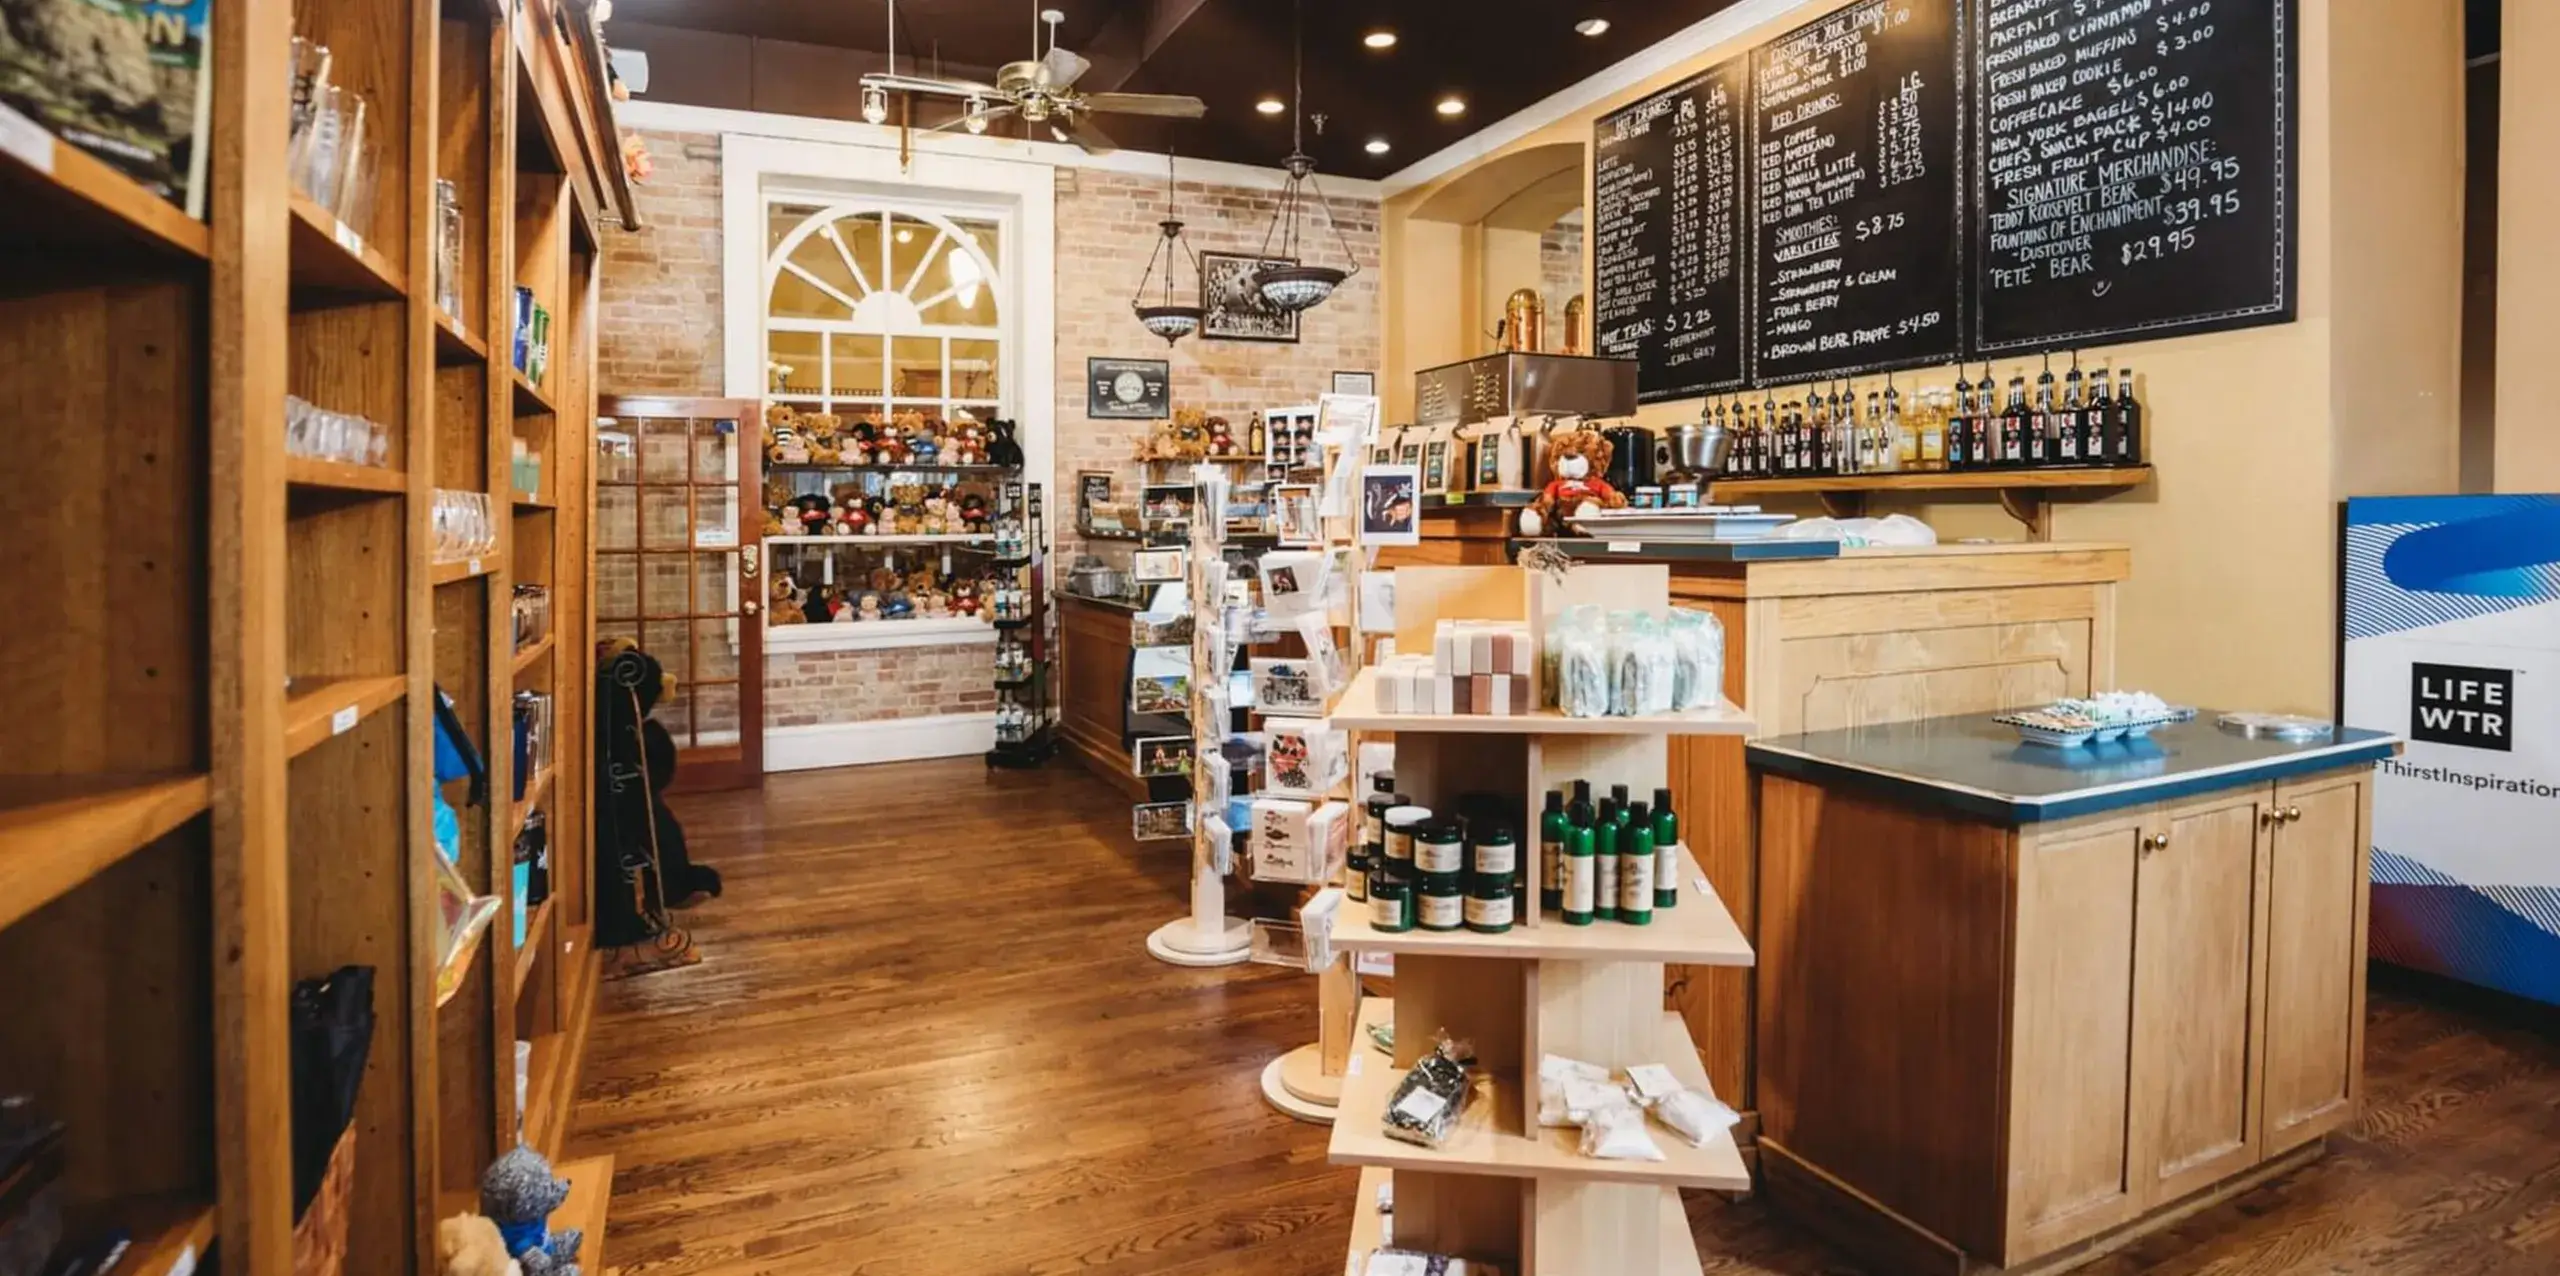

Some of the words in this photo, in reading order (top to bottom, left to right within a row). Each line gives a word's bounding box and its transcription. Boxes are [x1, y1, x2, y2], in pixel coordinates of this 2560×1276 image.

[1990, 9, 2060, 48] PARFAIT
[2024, 32, 2061, 56] BAKED
[2028, 53, 2067, 79] BAKED
[2075, 28, 2138, 63] MUFFINS
[2030, 75, 2067, 102] BAKED
[2072, 57, 2123, 87] COOKIE
[1783, 125, 1818, 149] COFFEE
[1991, 133, 2022, 155] NEW
[2027, 121, 2067, 144] YORK
[2073, 99, 2134, 129] BAGEL
[2041, 130, 2089, 160] SNACK
[2093, 114, 2142, 143] PACK
[2151, 92, 2214, 126] $14.00
[1783, 134, 1836, 164] AMERICANO
[1992, 163, 2042, 190] FRESH
[2156, 116, 2212, 143] $4.00
[1783, 169, 1821, 190] VANILLA
[2008, 171, 2088, 207] SIGNATURE
[2098, 138, 2217, 186] MERCHANDISE:
[1989, 208, 2025, 232] TEDDY
[2028, 192, 2093, 223] ROOSEVELT
[2100, 182, 2139, 209] BEAR
[2159, 156, 2241, 195] $49.95
[1990, 225, 2049, 253] FOUNTAINS
[2049, 219, 2067, 240] OF
[2070, 195, 2164, 236] ENCHANTMENT
[2163, 189, 2241, 226] $39.95
[2050, 253, 2095, 280] BEAR
[2120, 226, 2198, 267] $29.95
[1845, 275, 1855, 287] &
[1857, 269, 1897, 286] CREAM
[1805, 295, 1840, 313] BERRY
[1601, 327, 1621, 347] HOT
[1820, 332, 1851, 351] BEAR
[2421, 676, 2504, 706] LIFE
[2419, 705, 2504, 737] WTR
